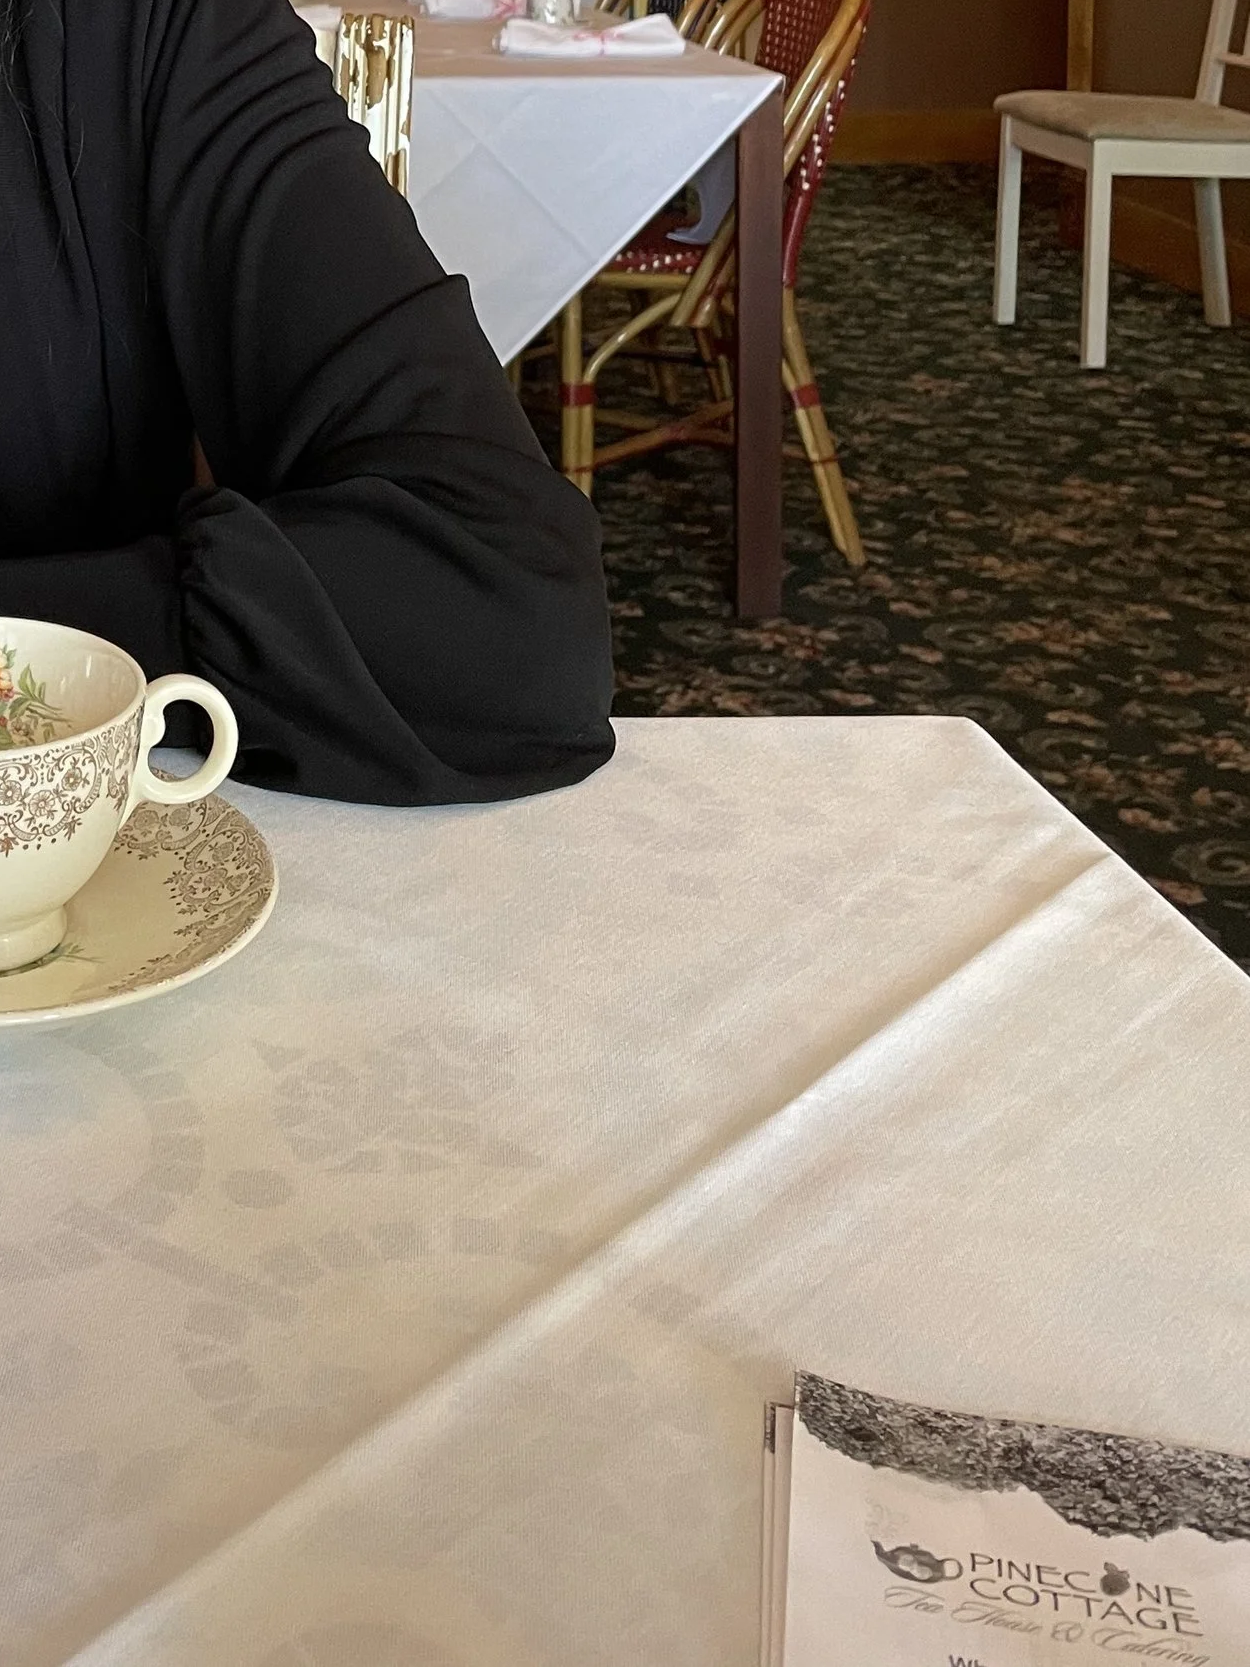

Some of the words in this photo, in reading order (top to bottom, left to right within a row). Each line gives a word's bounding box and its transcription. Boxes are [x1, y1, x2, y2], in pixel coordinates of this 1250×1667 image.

[969, 1577, 1204, 1637] COTTAGE
[970, 1552, 1195, 1611] PINECNE
[884, 1585, 946, 1614] Tea
[950, 1601, 1043, 1633] House
[1091, 1627, 1211, 1667] Catering
